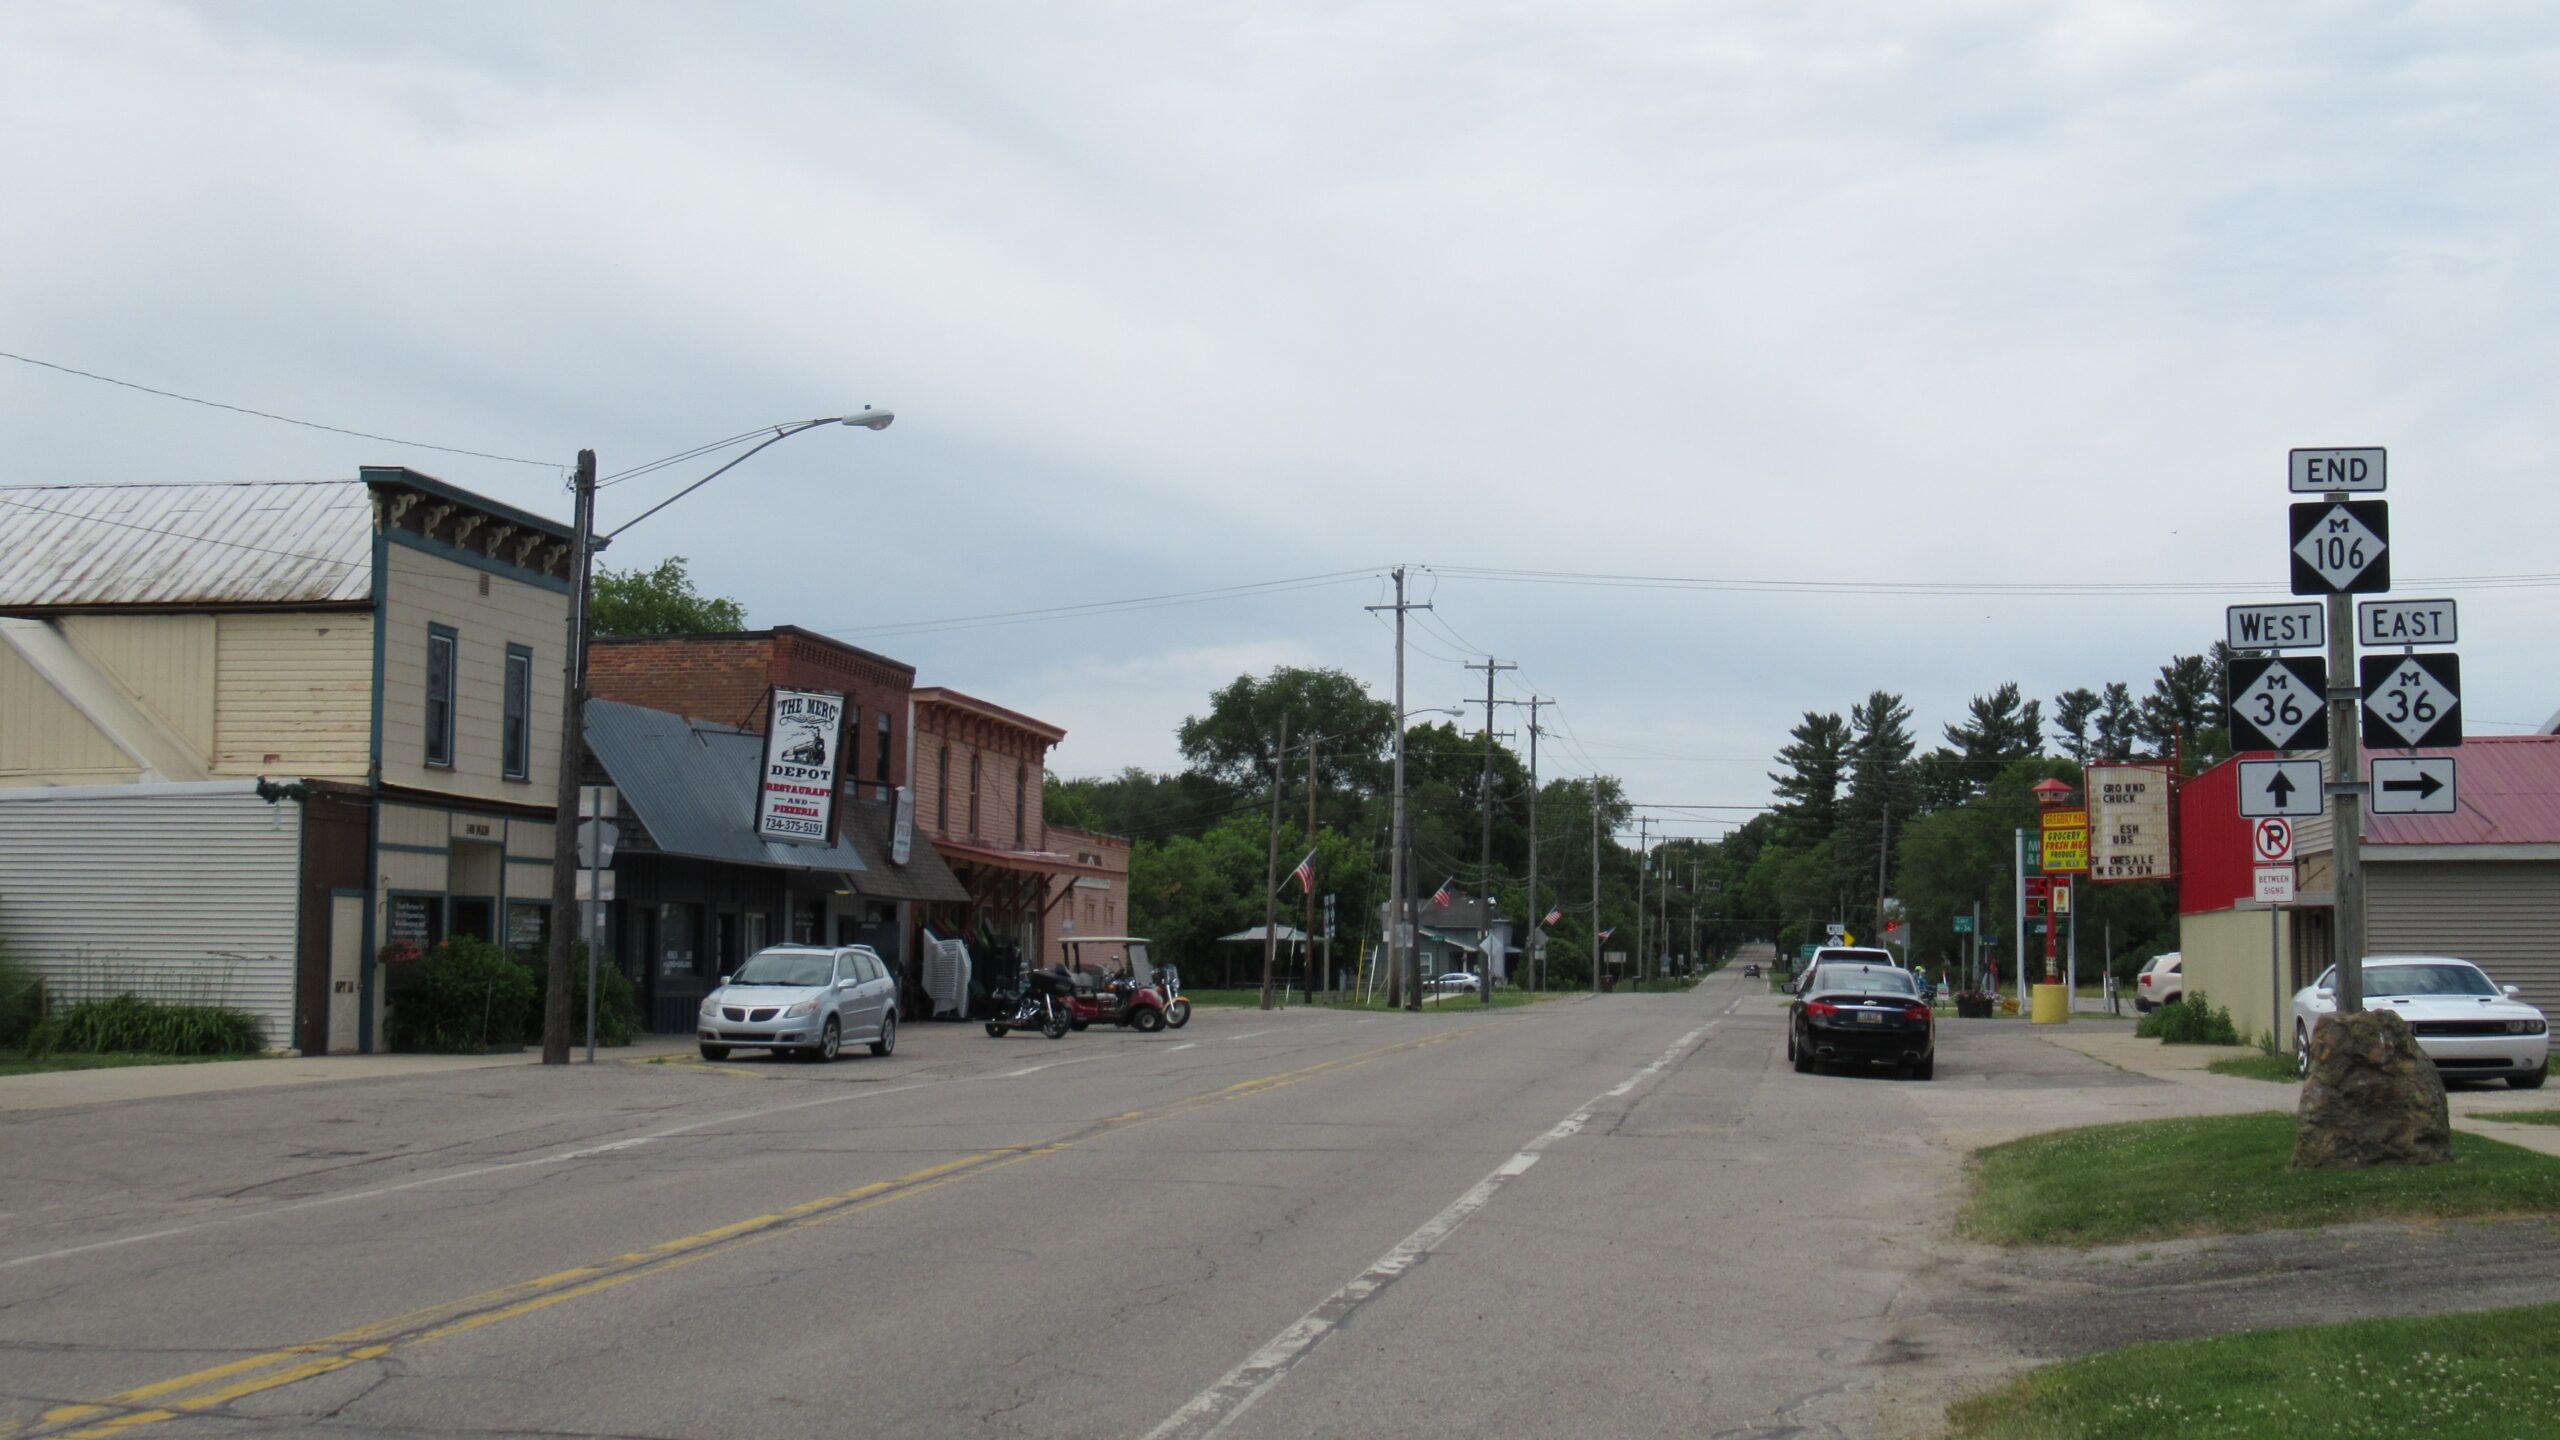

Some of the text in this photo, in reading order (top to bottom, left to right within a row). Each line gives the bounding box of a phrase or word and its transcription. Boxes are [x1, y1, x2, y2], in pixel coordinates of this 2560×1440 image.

[2307, 458, 2367, 482] END
[2329, 518, 2349, 533] M
[2315, 536, 2364, 570] 106
[2239, 612, 2311, 641] WEST
[2373, 609, 2442, 637] EAST
[2266, 675, 2287, 689] M
[2400, 672, 2420, 686] M
[2253, 693, 2303, 726] 36
[2386, 689, 2436, 723] 36
[770, 765, 831, 780] DEPOT
[766, 783, 832, 797] RESTAURANT
[2103, 794, 2135, 803] CHUCK
[773, 804, 819, 817] PIZZERIA
[766, 817, 823, 834] 734-375-5191
[2045, 813, 2071, 825] GREGORY
[2047, 831, 2081, 840] GROCERY
[2045, 841, 2068, 850] FRESH
[2050, 850, 2077, 858] PRODUCE
[2128, 866, 2153, 876] SUN
[2258, 874, 2289, 883] BETWEEN
[2264, 887, 2285, 895] SIGNS
